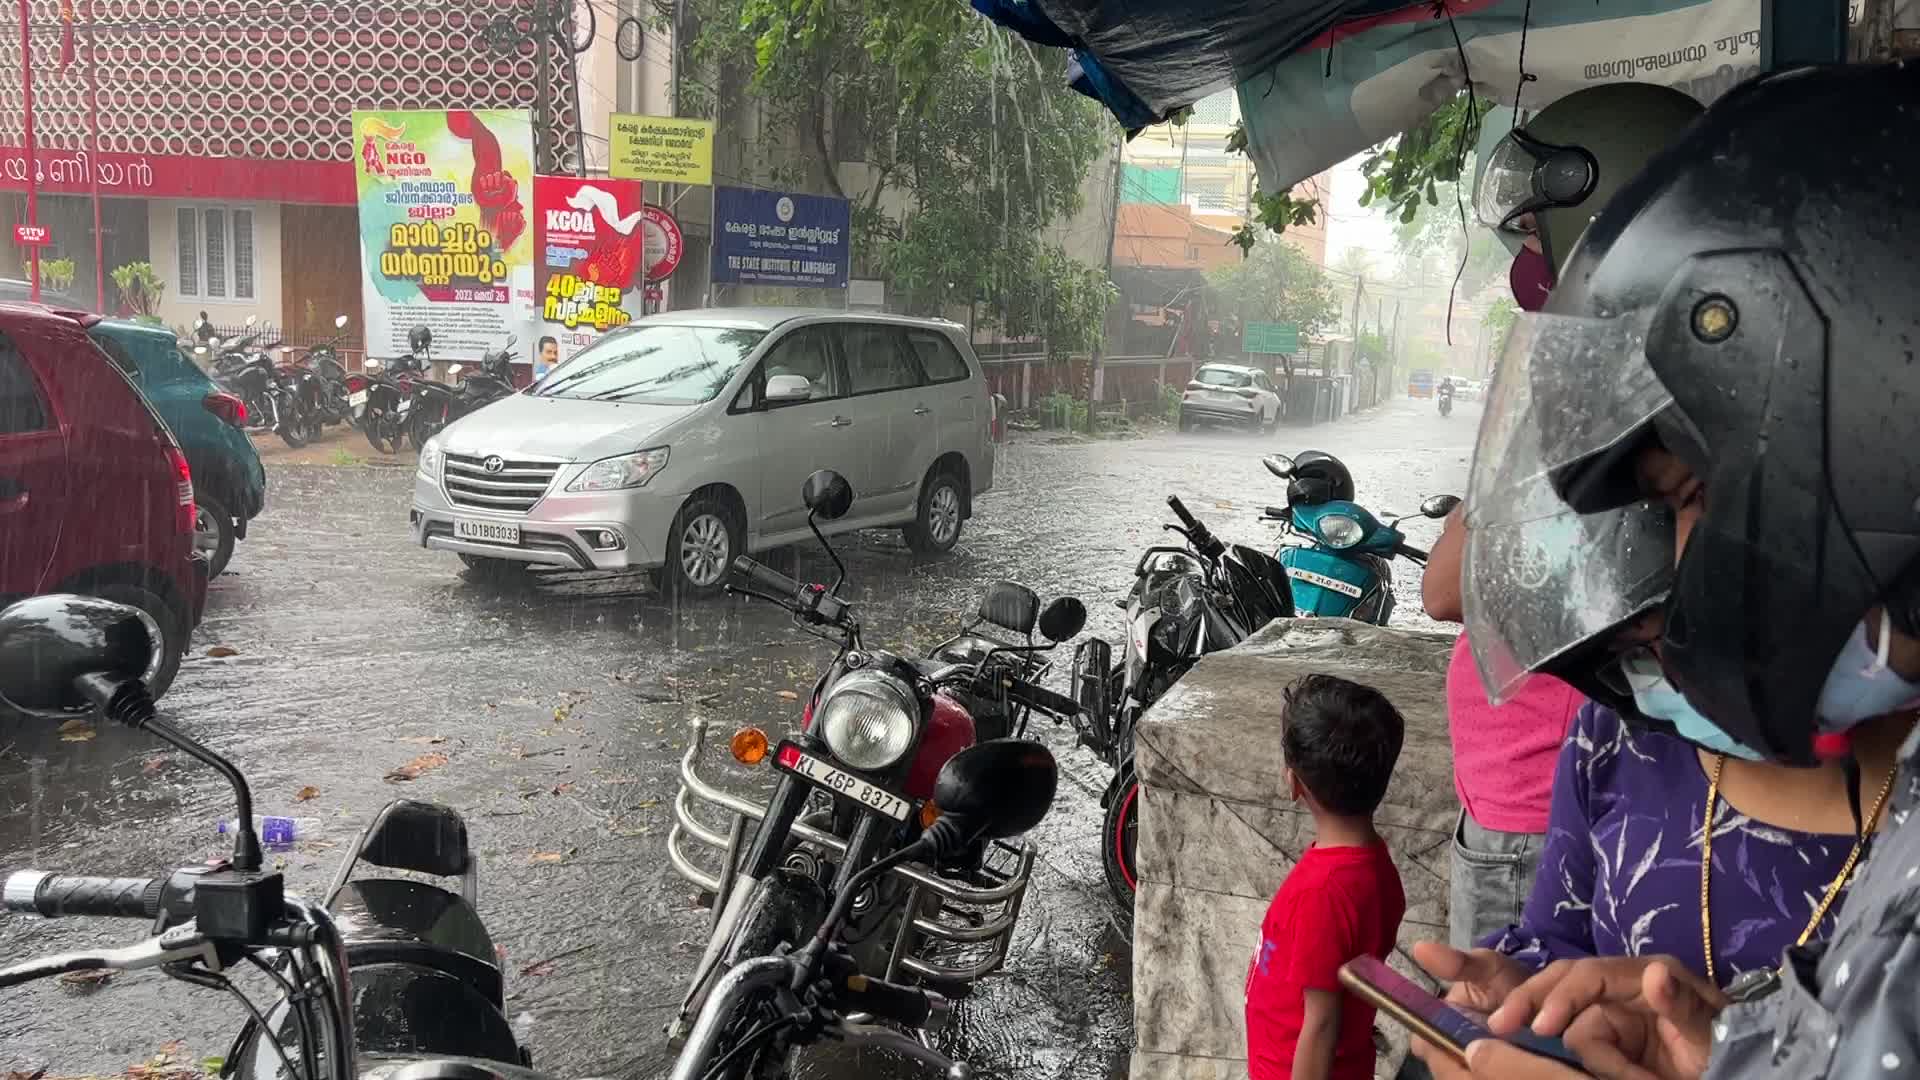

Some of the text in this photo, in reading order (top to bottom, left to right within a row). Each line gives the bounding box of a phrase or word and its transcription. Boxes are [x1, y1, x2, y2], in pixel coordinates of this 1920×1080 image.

[387, 152, 426, 165] NGO
[401, 182, 456, 194] സംസ്ഥാന
[407, 205, 456, 219] ജില്ലാ
[546, 210, 595, 233] KGOA
[18, 227, 45, 237] CITU
[391, 219, 492, 253] മാർച്ചും
[725, 221, 757, 238] കേരള
[381, 248, 507, 285] ധർണ്ണയും
[728, 256, 741, 269] THE
[742, 256, 760, 271] STATE
[455, 288, 473, 301] 2022
[495, 290, 505, 302] 26
[796, 754, 902, 817] KL 46P 8371
